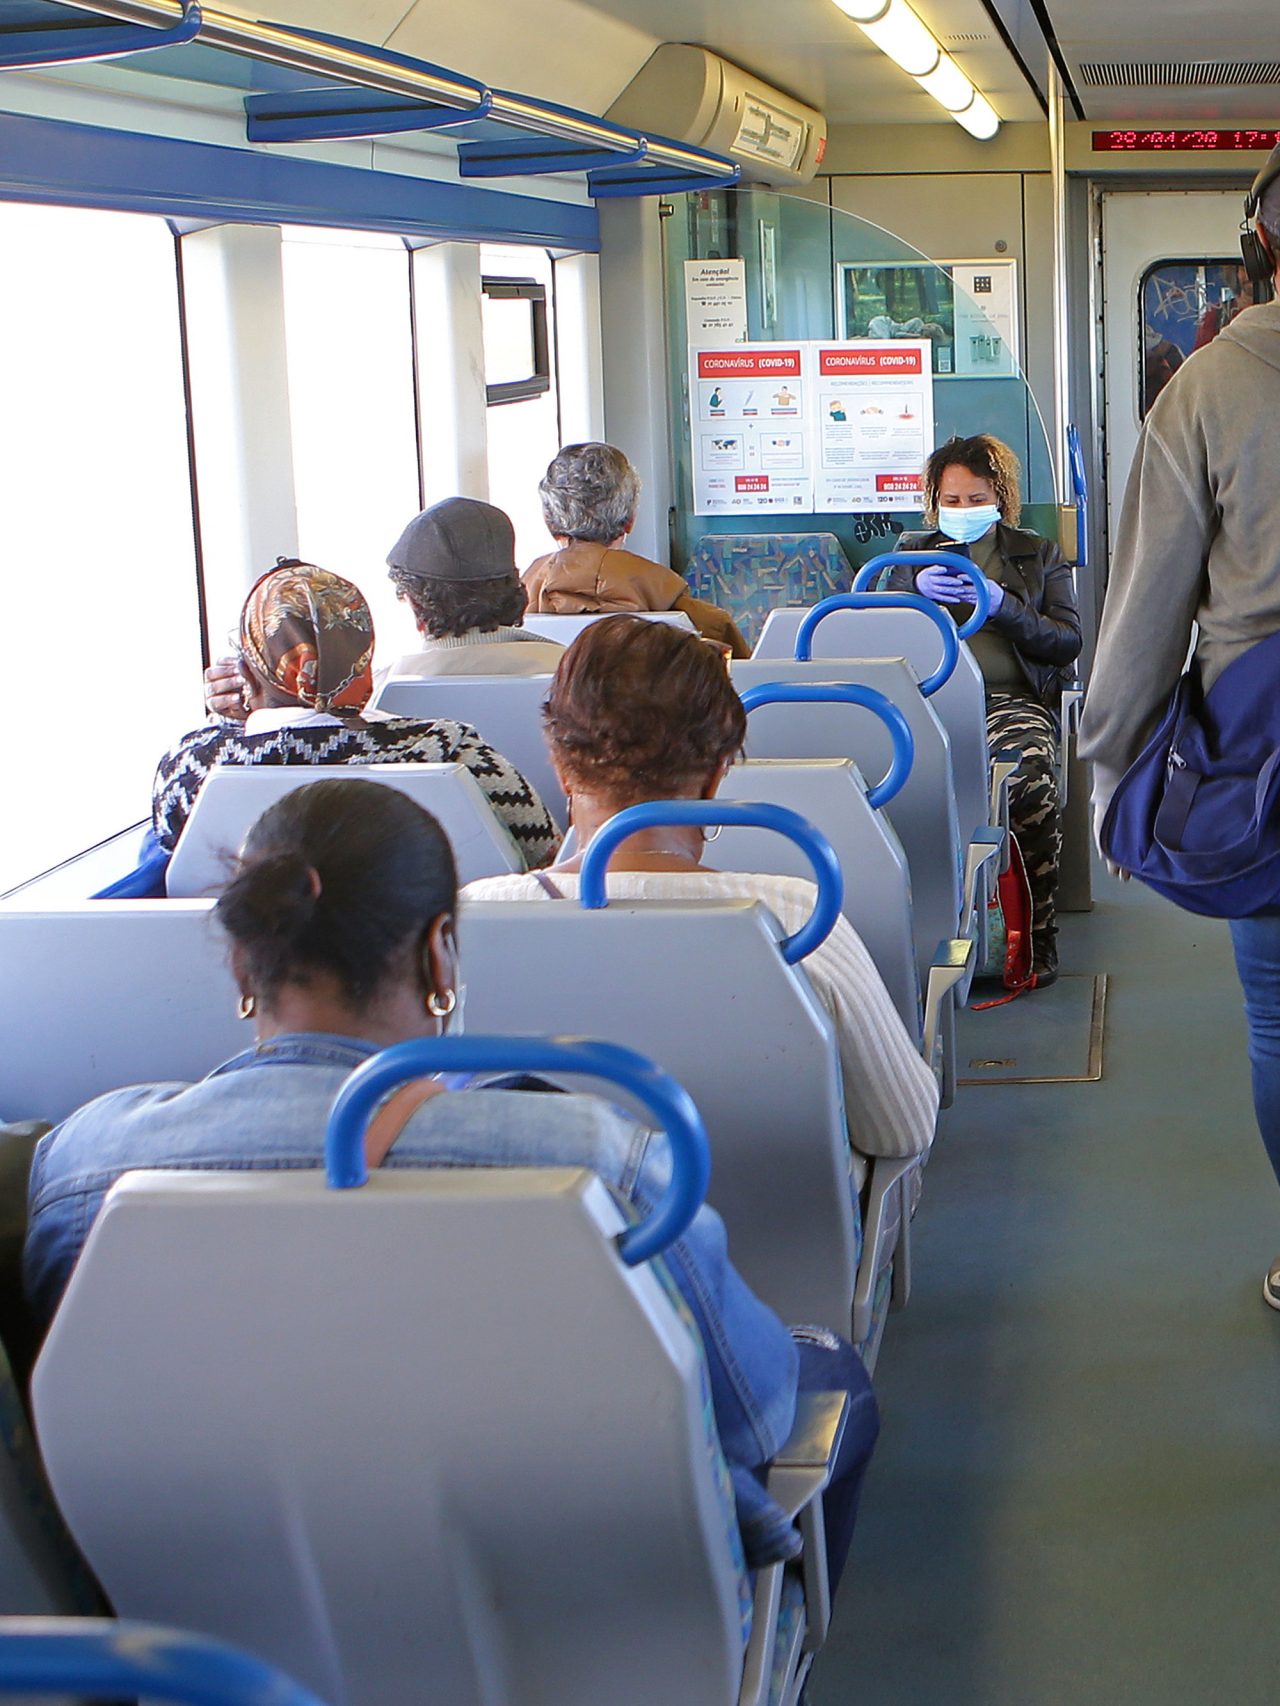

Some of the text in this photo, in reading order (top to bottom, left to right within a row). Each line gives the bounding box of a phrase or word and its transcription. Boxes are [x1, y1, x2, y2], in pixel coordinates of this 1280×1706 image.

[1234, 131, 1280, 148] 17:1
[704, 357, 795, 369] CORONAVÍRUS (COVID-19)
[825, 355, 916, 367] CORONAVÍRUS (COVID-19)
